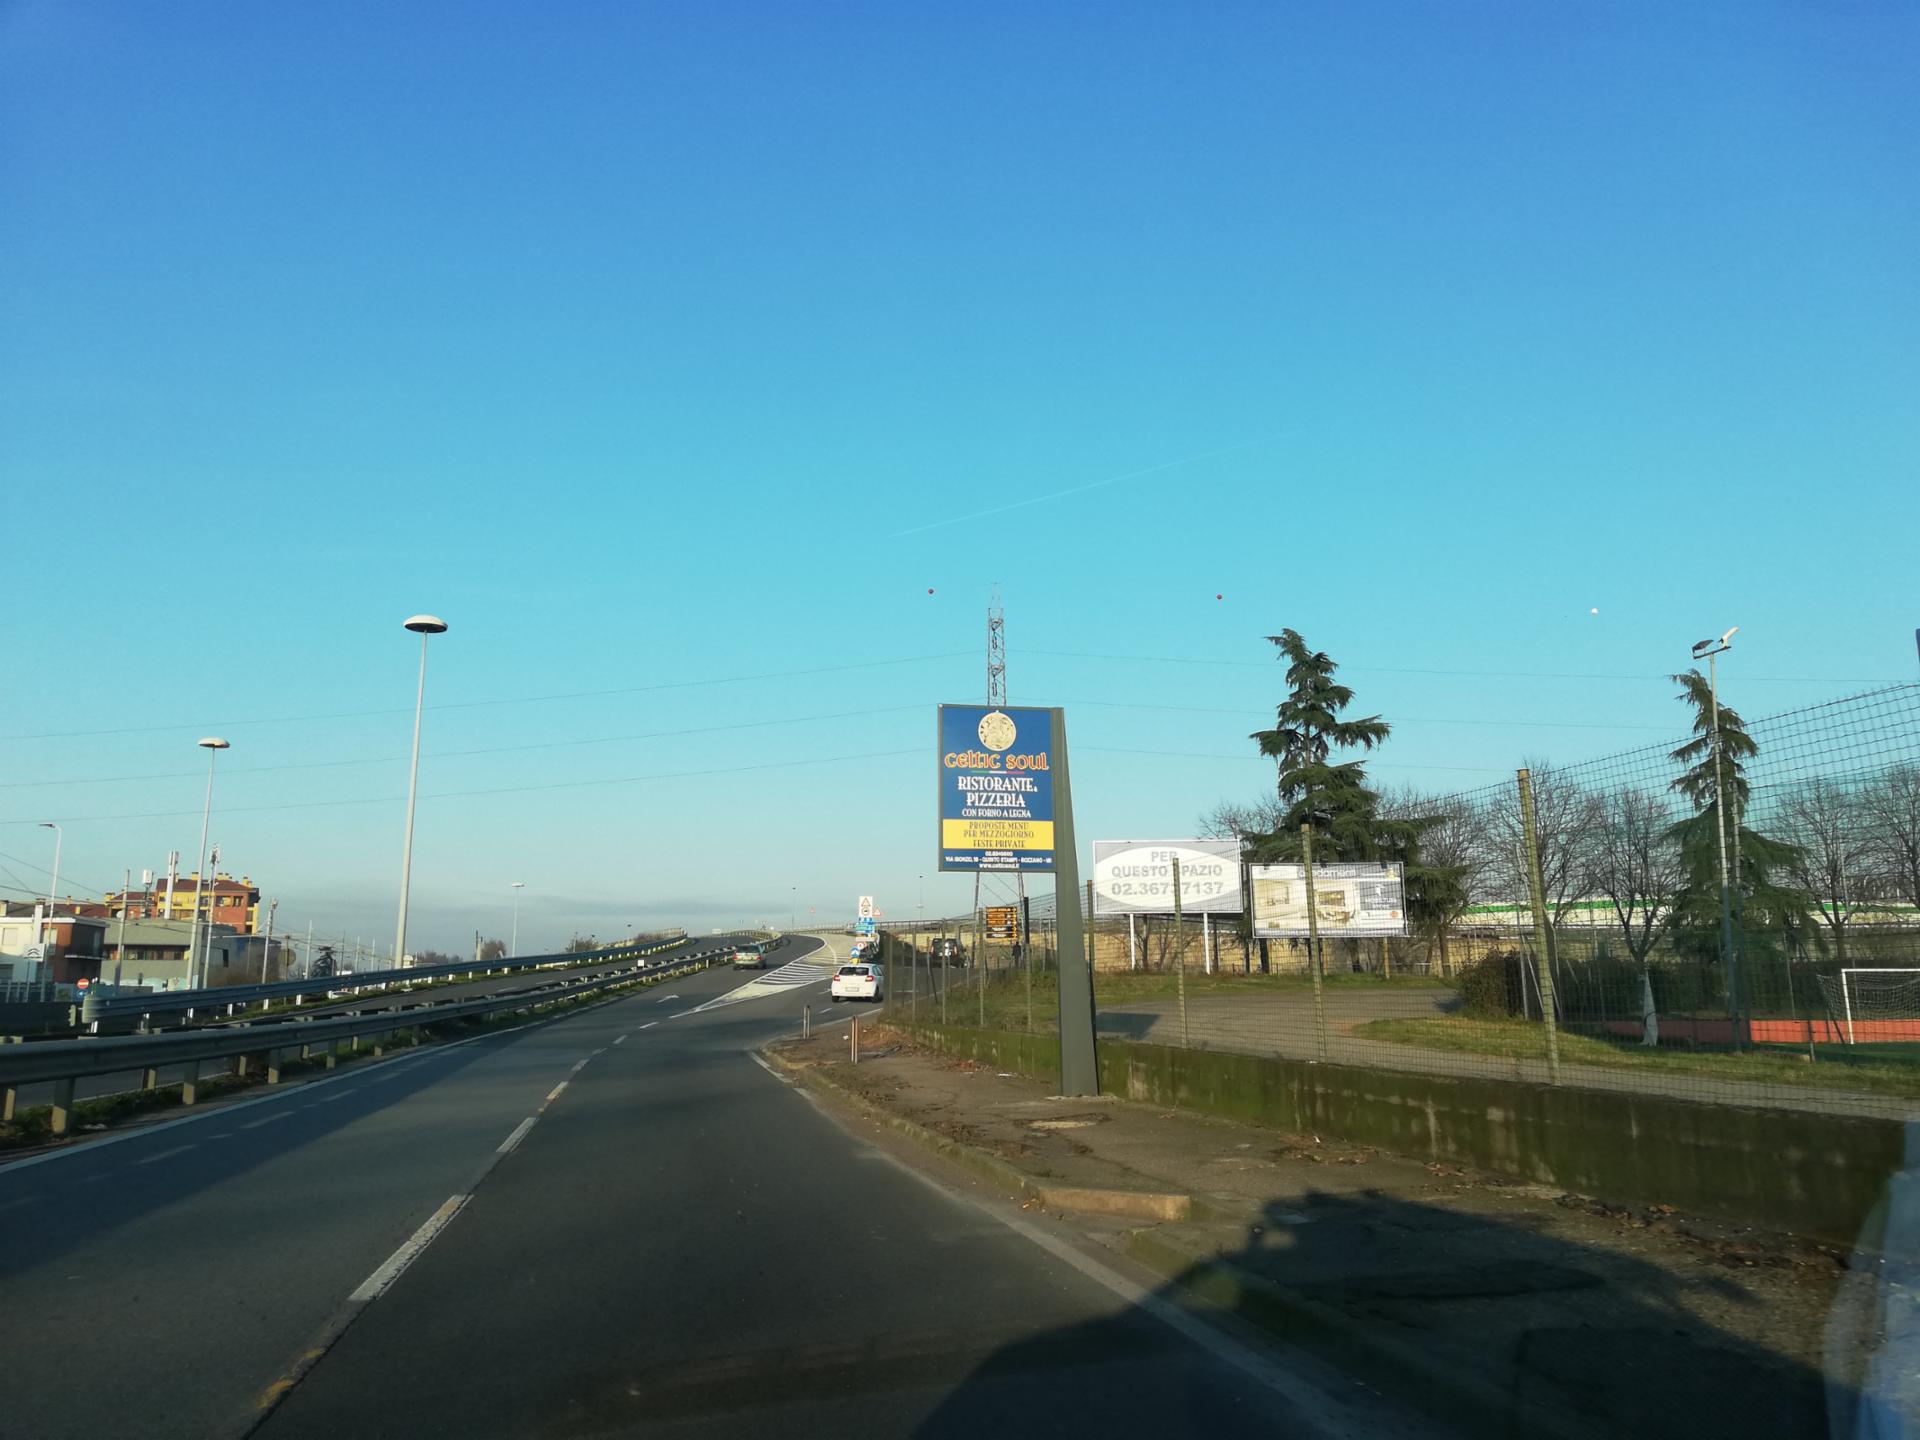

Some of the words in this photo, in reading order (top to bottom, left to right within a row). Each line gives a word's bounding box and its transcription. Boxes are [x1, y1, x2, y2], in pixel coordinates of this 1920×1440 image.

[1005, 752, 1049, 770] soul
[966, 792, 1026, 807] PIZZERIA
[962, 808, 977, 817] CON
[978, 809, 1001, 817] FORNO
[1002, 809, 1008, 817] A
[1009, 809, 1031, 818] LEGNA
[969, 822, 1006, 830] PROPOSTE
[979, 830, 1034, 838] MEZZOGIORNO
[995, 840, 1025, 848] PRIVATE
[1111, 865, 1168, 878] QUESTO
[1171, 864, 1223, 877] PAZIO
[1111, 881, 1224, 895] 02.3677137
